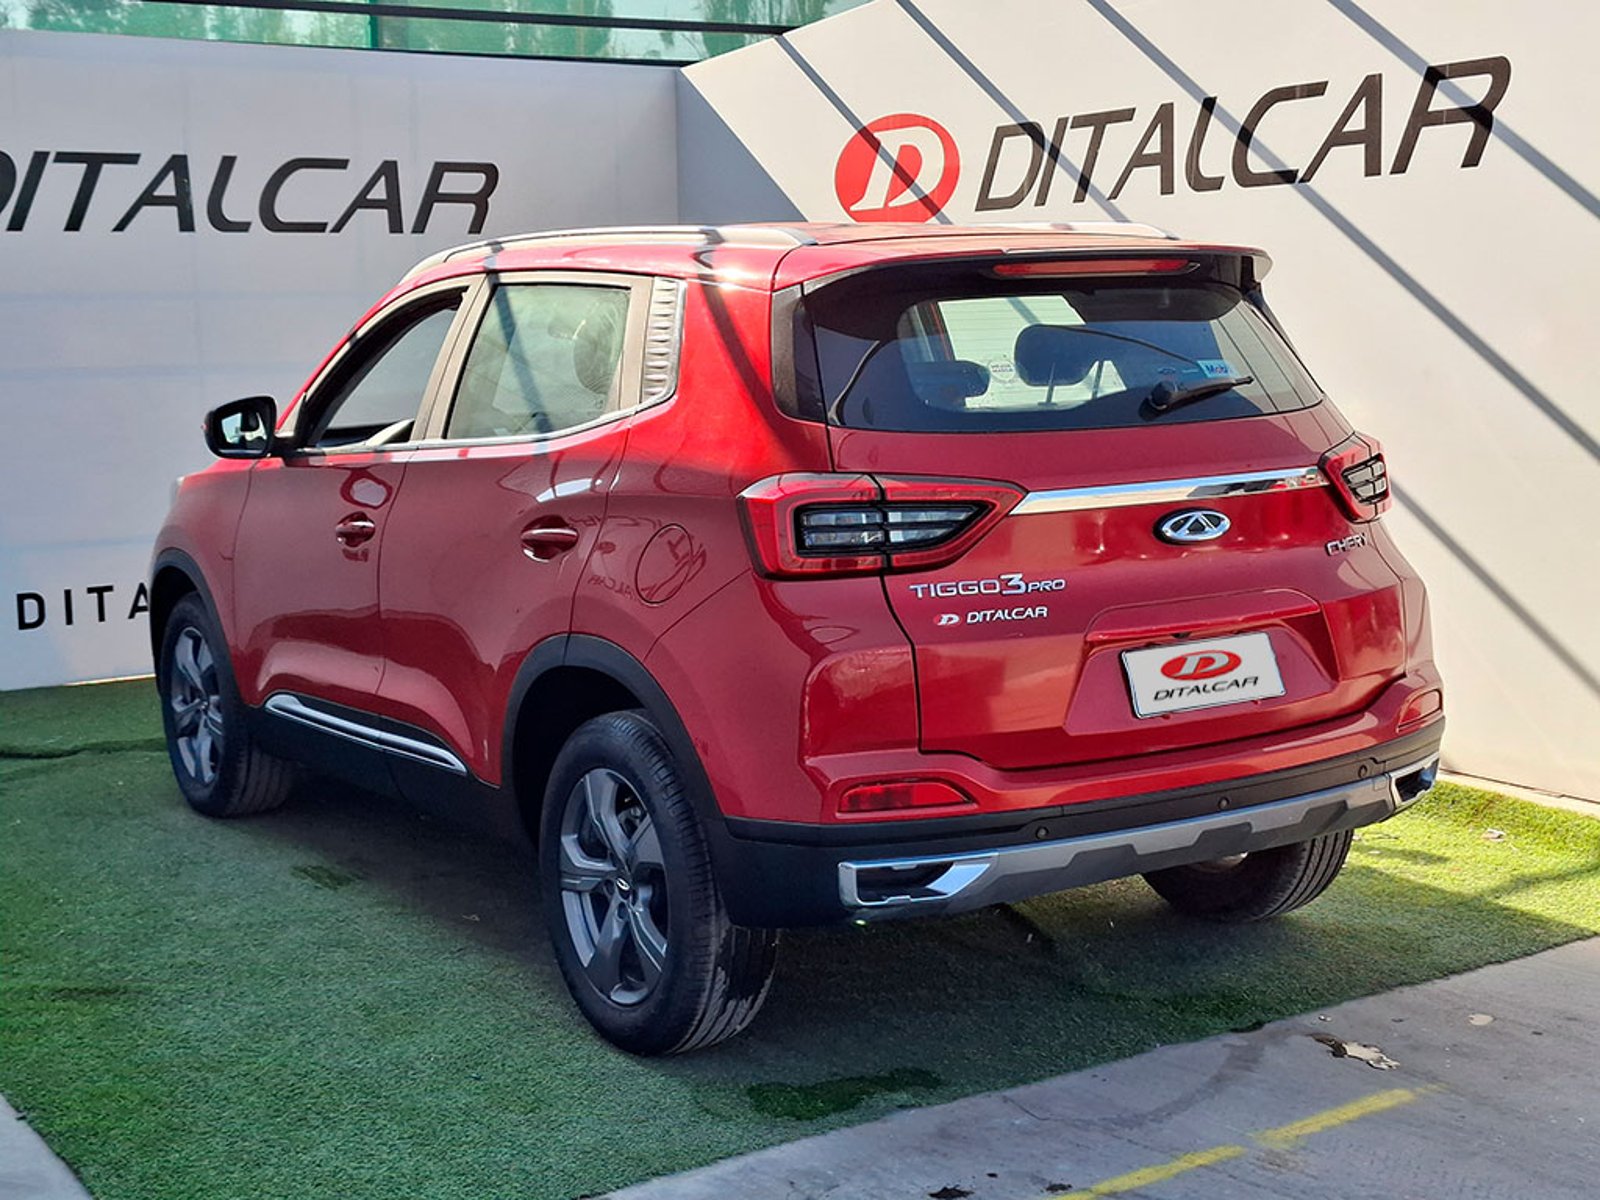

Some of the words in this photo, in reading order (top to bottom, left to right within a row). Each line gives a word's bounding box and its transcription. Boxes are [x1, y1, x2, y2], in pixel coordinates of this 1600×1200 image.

[974, 55, 1512, 212] DITALCAR
[0, 150, 500, 234] ITALCAR
[966, 606, 1048, 624] DITALCAR
[1153, 676, 1260, 701] DITALCAR
